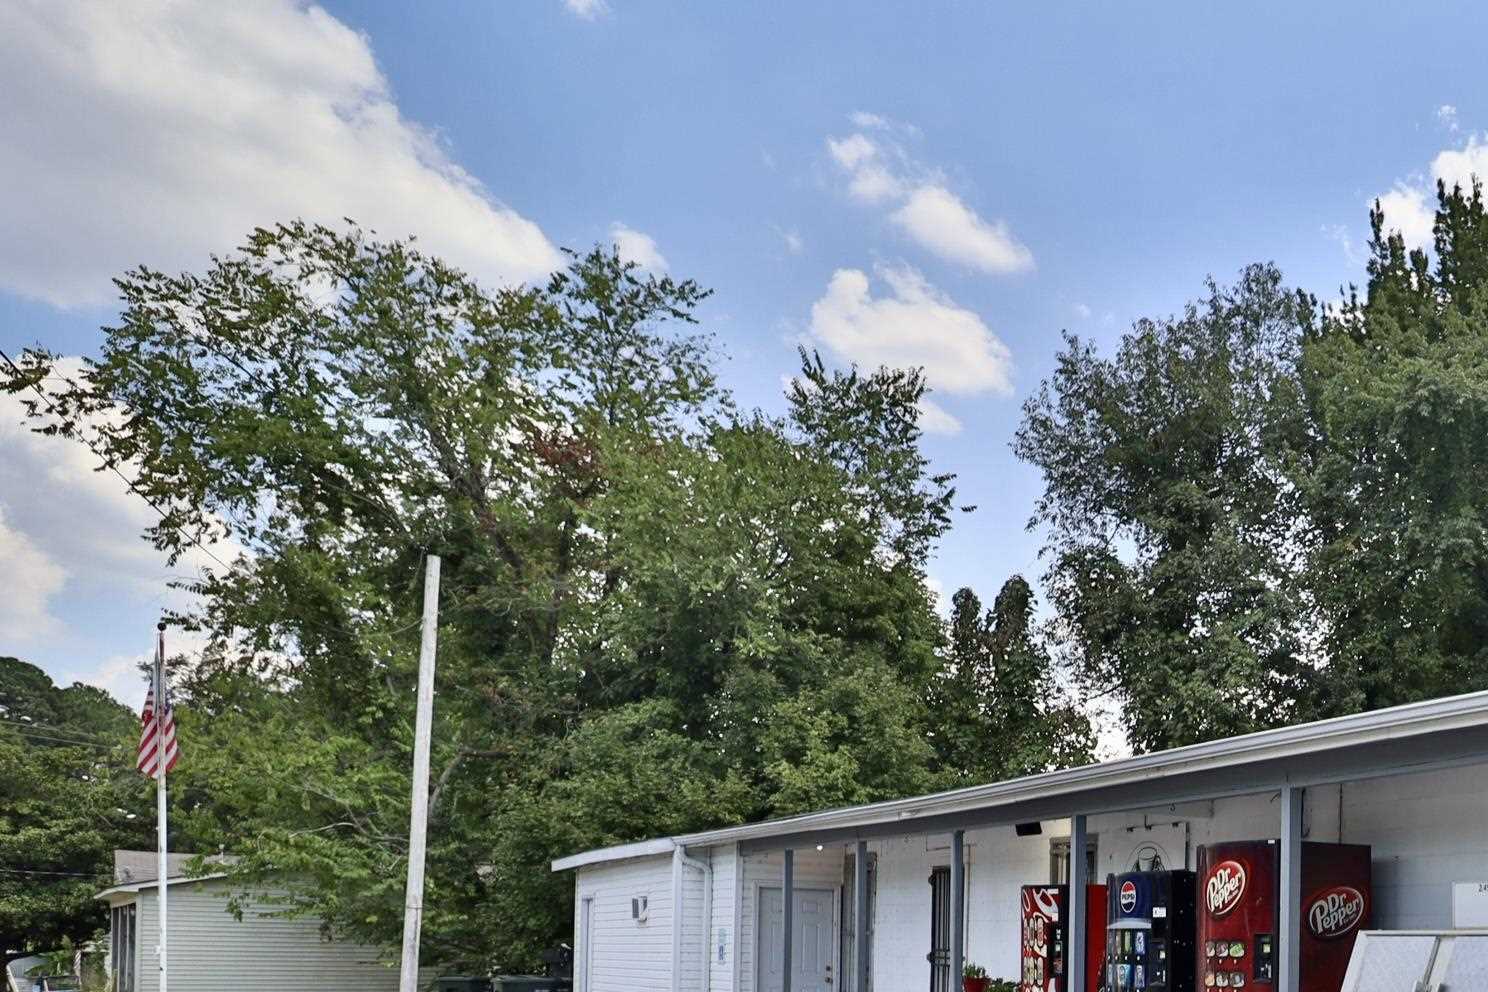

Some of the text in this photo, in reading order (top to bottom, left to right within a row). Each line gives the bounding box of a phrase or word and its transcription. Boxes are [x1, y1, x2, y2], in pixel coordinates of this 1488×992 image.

[1207, 872, 1242, 912] Pepper
[1217, 868, 1231, 890] Dr
[1309, 893, 1359, 934] Dr Pepper
